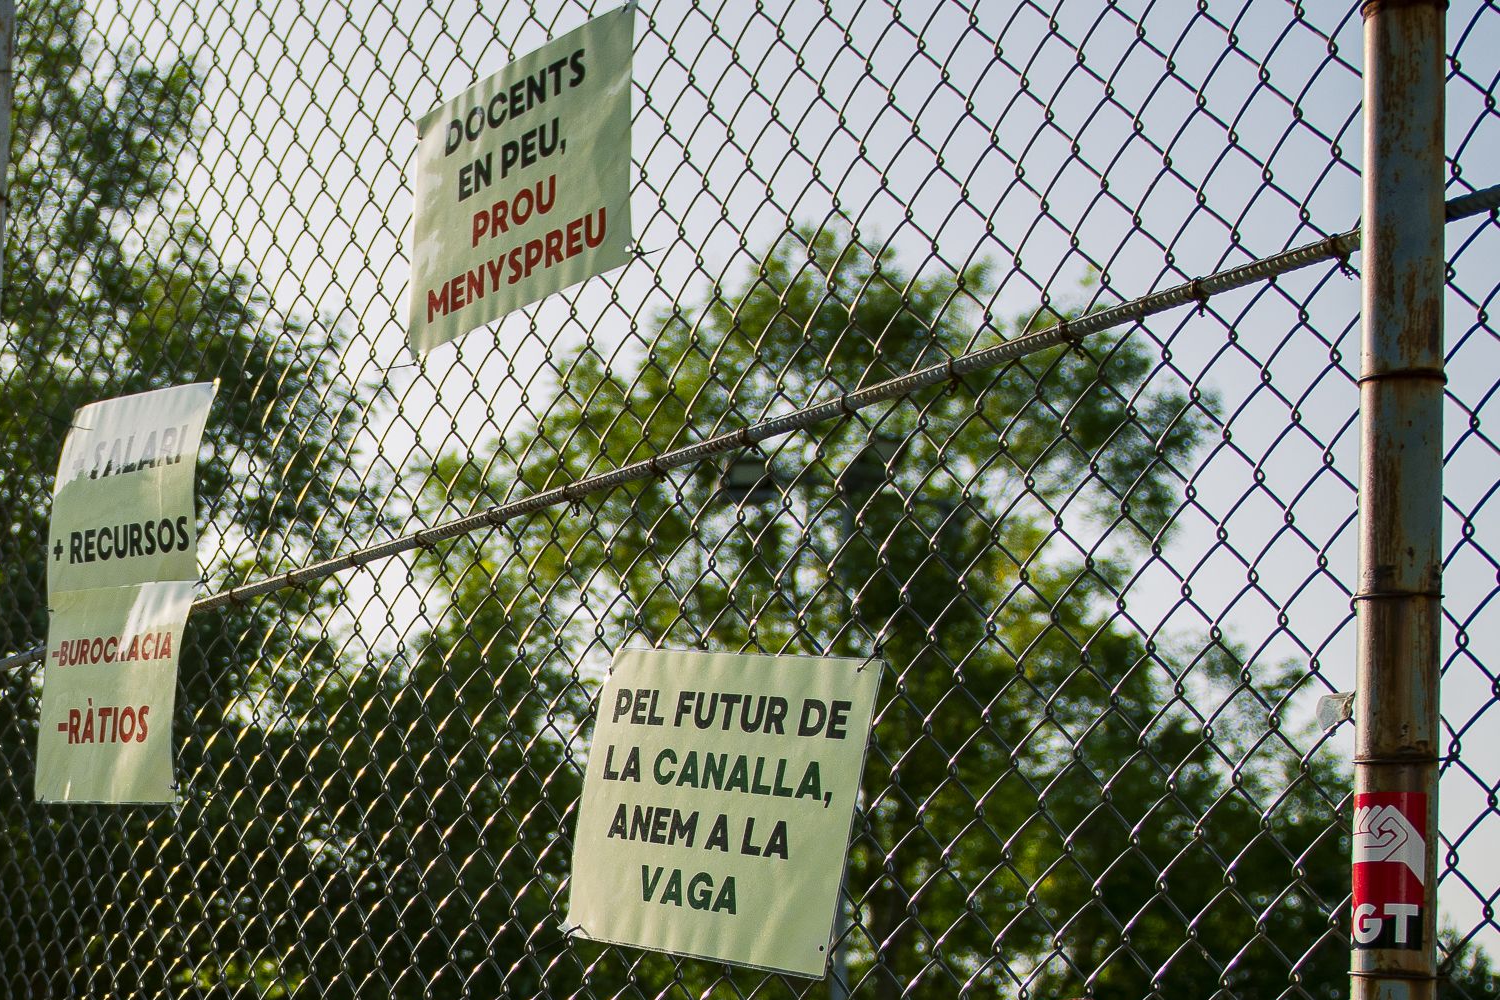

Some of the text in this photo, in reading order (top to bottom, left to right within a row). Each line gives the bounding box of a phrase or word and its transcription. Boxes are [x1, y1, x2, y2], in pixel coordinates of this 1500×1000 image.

[445, 48, 586, 157] DOCENTS
[458, 117, 567, 202] EN PEU,
[472, 174, 557, 248] PROU
[427, 206, 607, 324] MENYSPREU
[90, 424, 189, 480] SALARI
[70, 515, 190, 564] RECURSOS
[612, 688, 852, 740] PEL FUTUR DE
[603, 745, 832, 809] LA CANALLA,
[607, 803, 789, 860] ANEM A LA
[641, 864, 737, 915] VAGA
